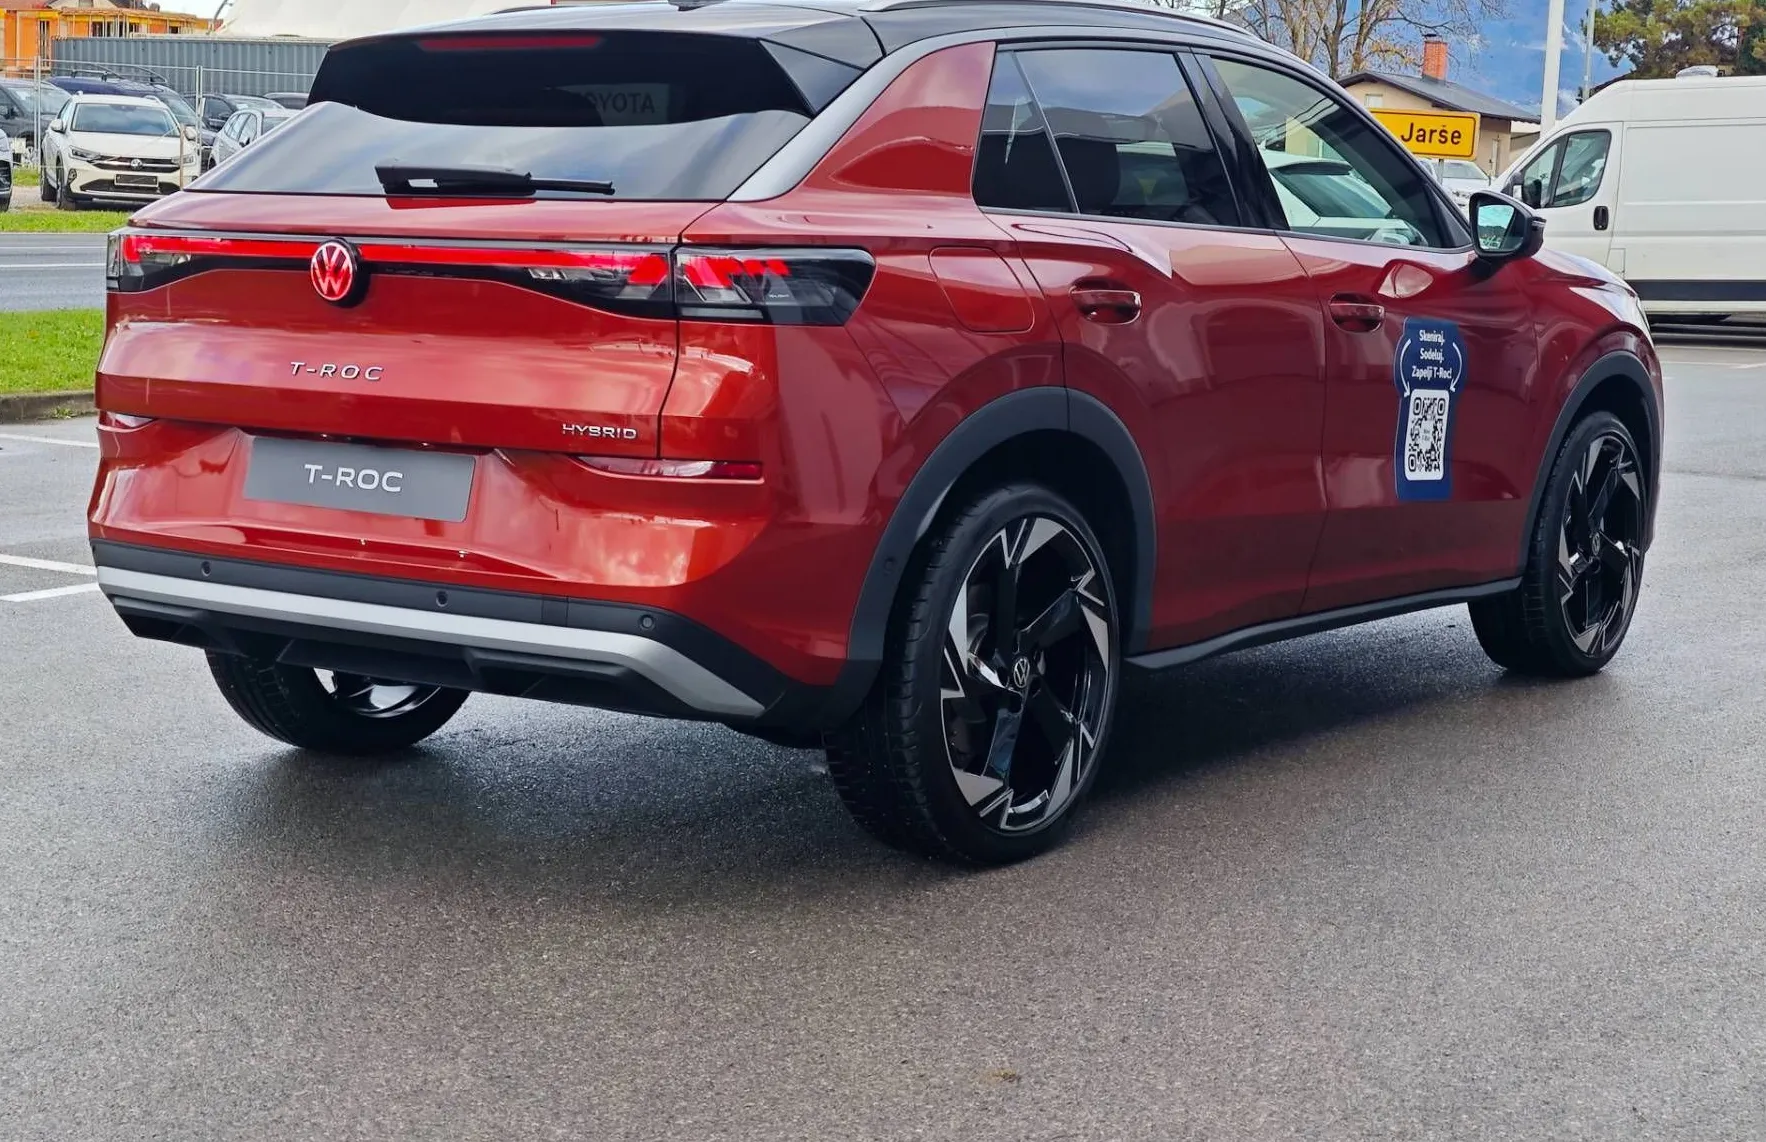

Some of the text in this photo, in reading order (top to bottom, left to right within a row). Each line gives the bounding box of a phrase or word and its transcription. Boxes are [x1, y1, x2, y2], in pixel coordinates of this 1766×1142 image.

[1400, 122, 1462, 146] Jarše
[290, 361, 384, 381] T-ROC
[562, 423, 637, 439] HYBRID
[304, 463, 403, 493] T-ROC
